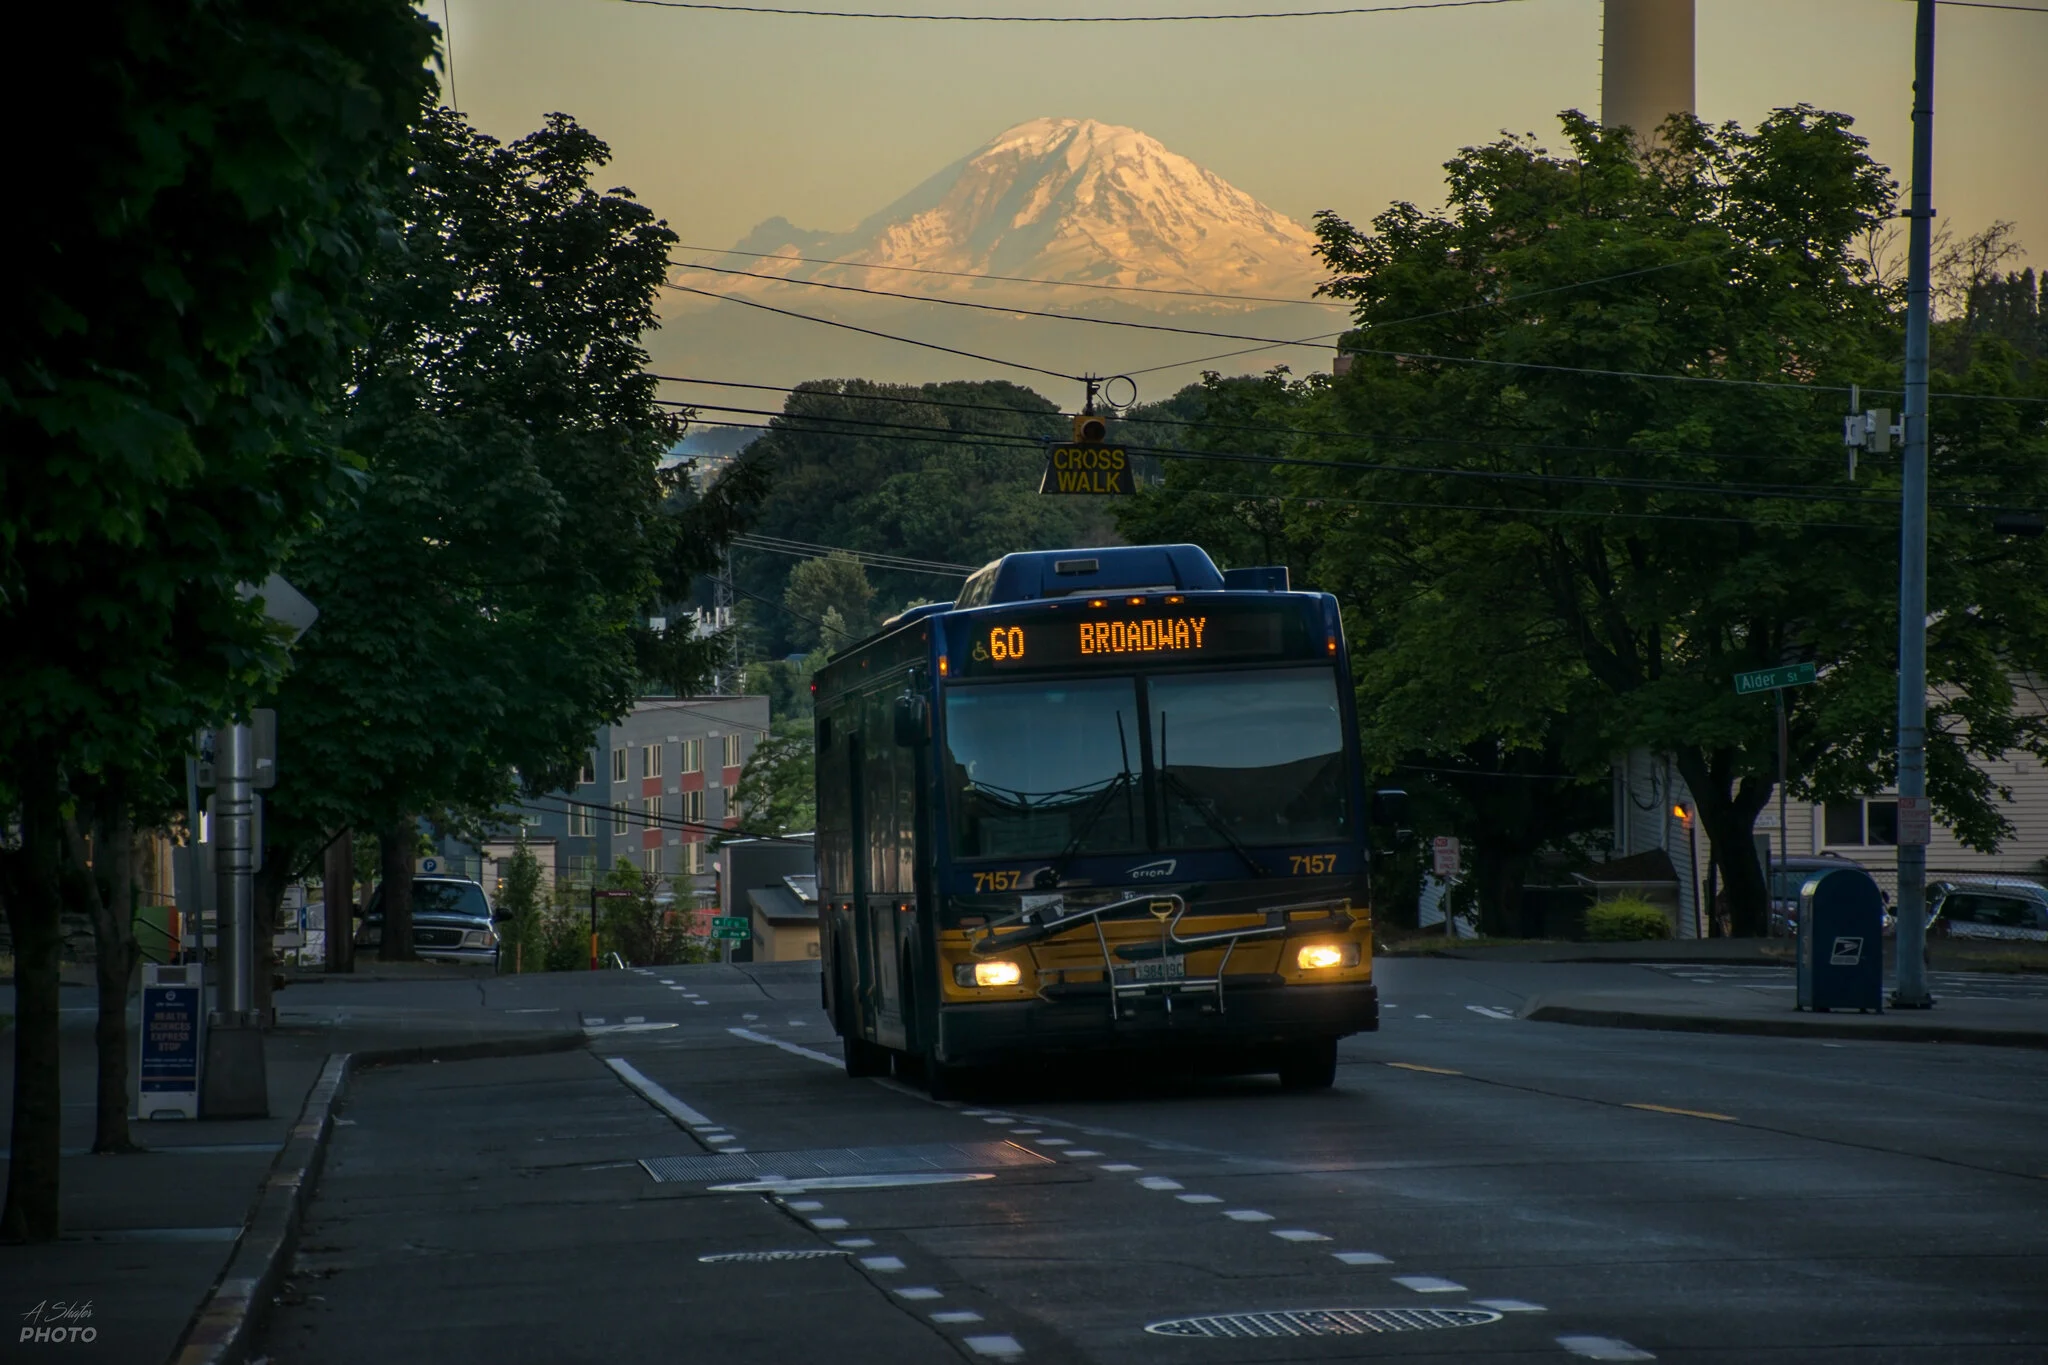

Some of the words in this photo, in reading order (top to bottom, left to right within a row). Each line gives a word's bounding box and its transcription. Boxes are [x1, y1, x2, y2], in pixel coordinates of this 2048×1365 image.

[1053, 447, 1126, 470] CROSS
[1056, 471, 1121, 493] WALK
[990, 625, 1025, 660] 60
[1079, 616, 1207, 654] BROADWAY
[1742, 673, 1776, 690] Alder
[1786, 671, 1799, 683] St
[1289, 853, 1337, 875] 7157
[972, 870, 1021, 894] 7157
[153, 1011, 189, 1021] HEALTH
[150, 1032, 190, 1041] EXPRESS
